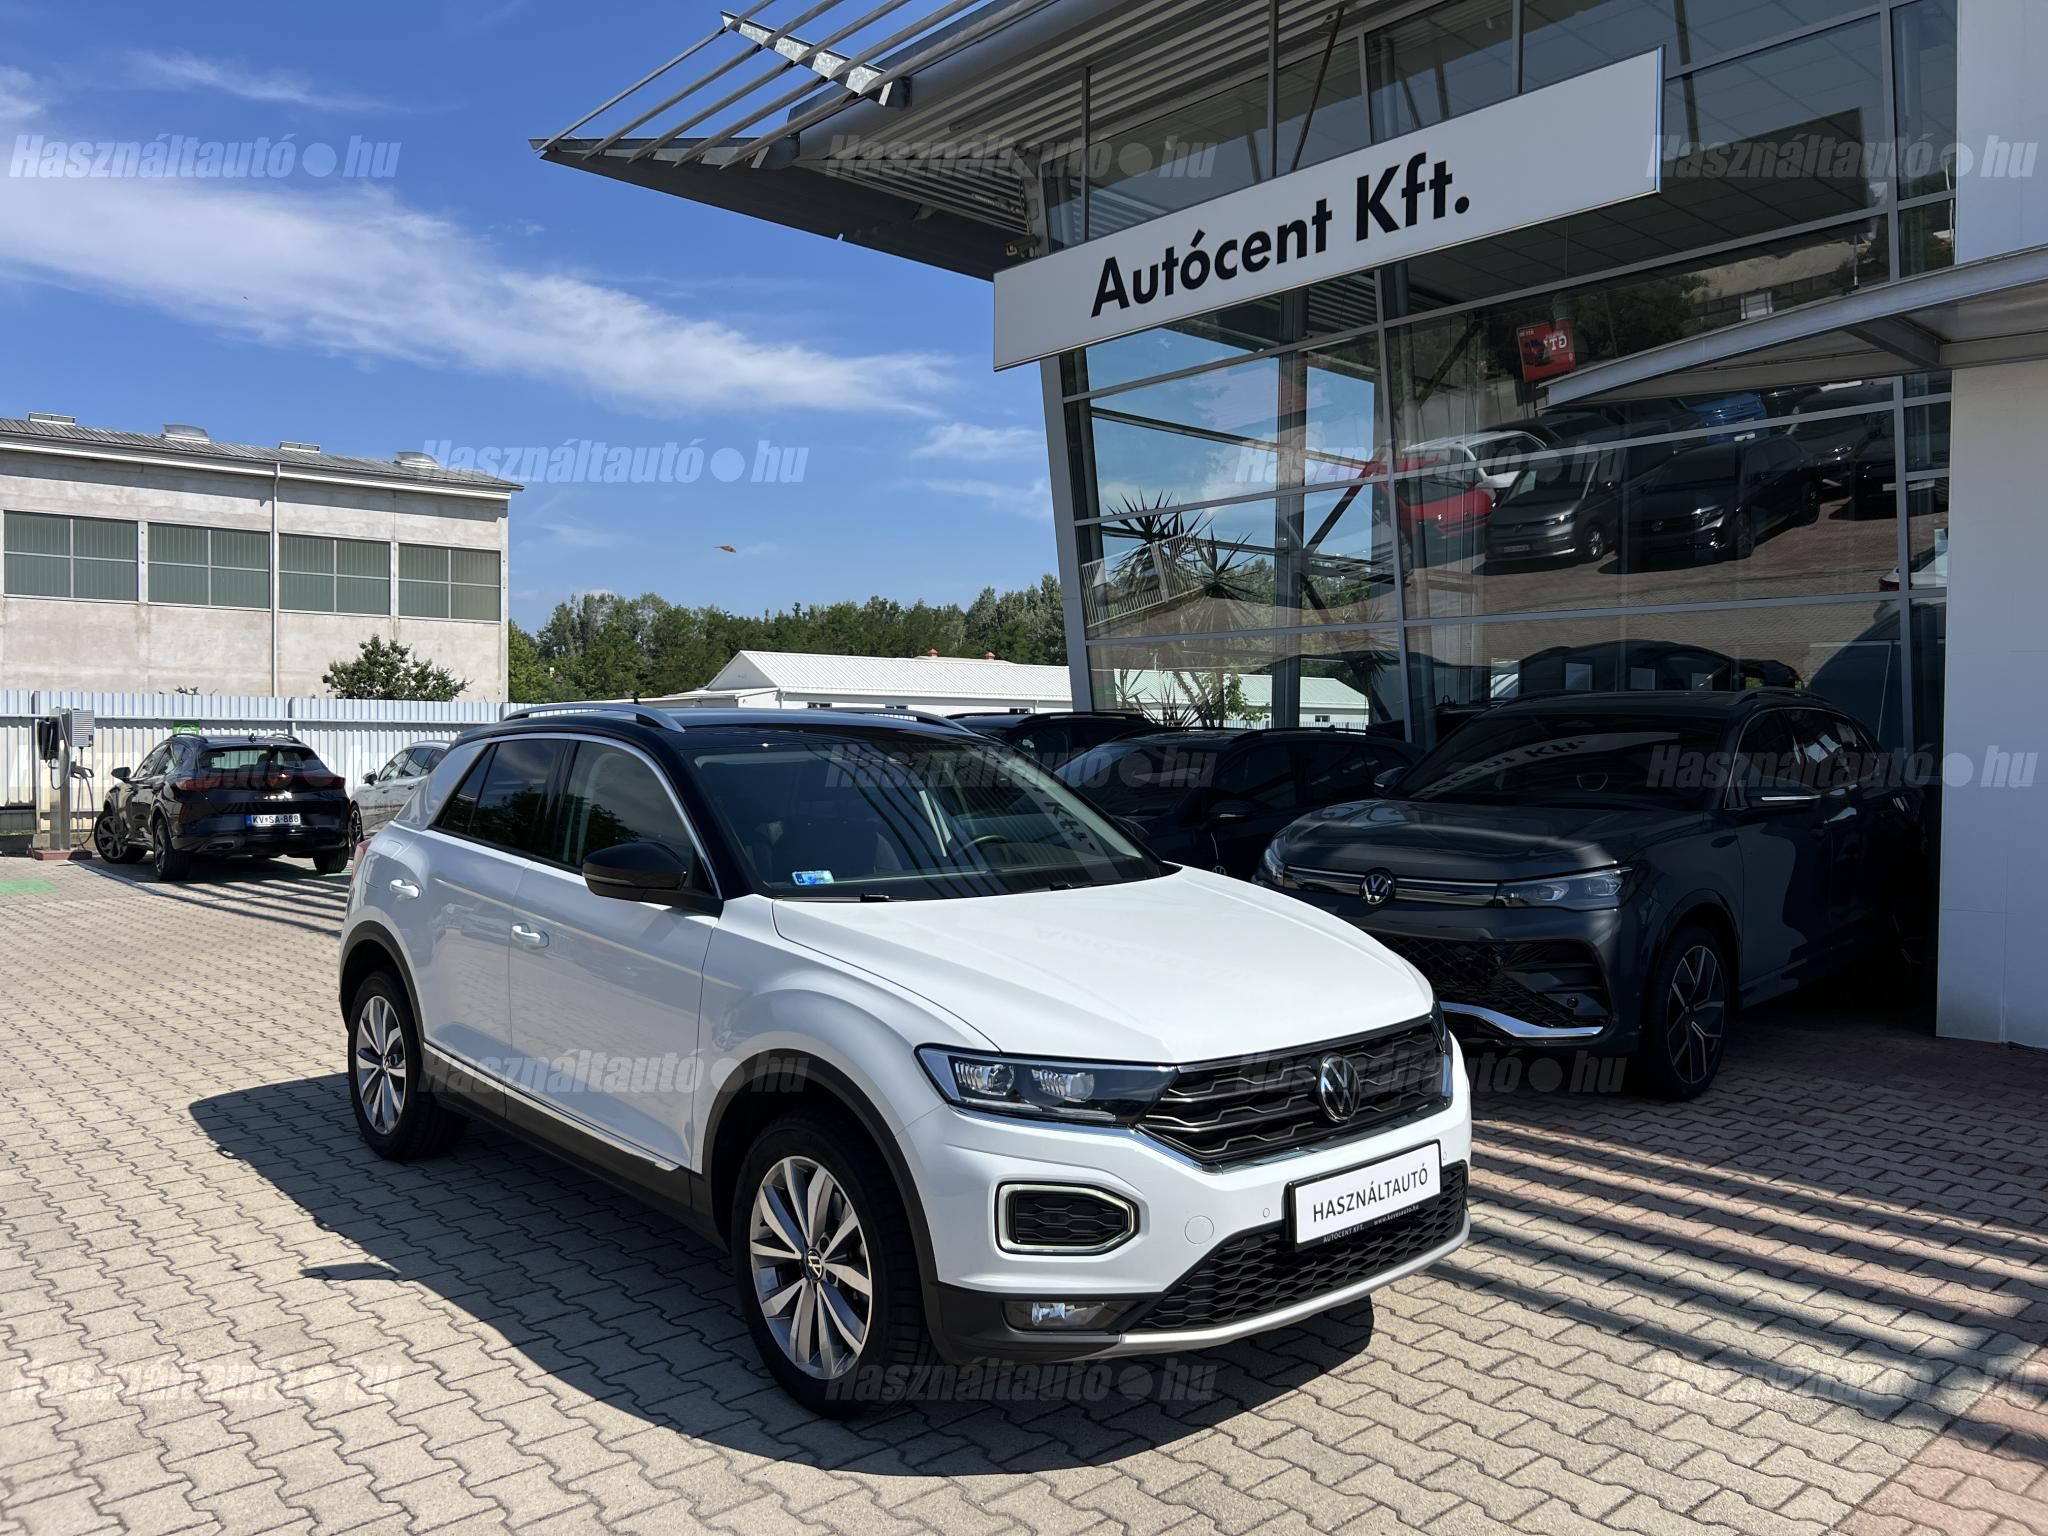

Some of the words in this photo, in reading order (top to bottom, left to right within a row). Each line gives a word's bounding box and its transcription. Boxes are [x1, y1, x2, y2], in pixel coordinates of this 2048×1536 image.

[1091, 198, 1333, 318] Autócent
[1356, 152, 1470, 242] Kft.
[1313, 1162, 1428, 1222] HASZNÁLTAUTÓ
[1323, 1228, 1352, 1243] AUTOCENT
